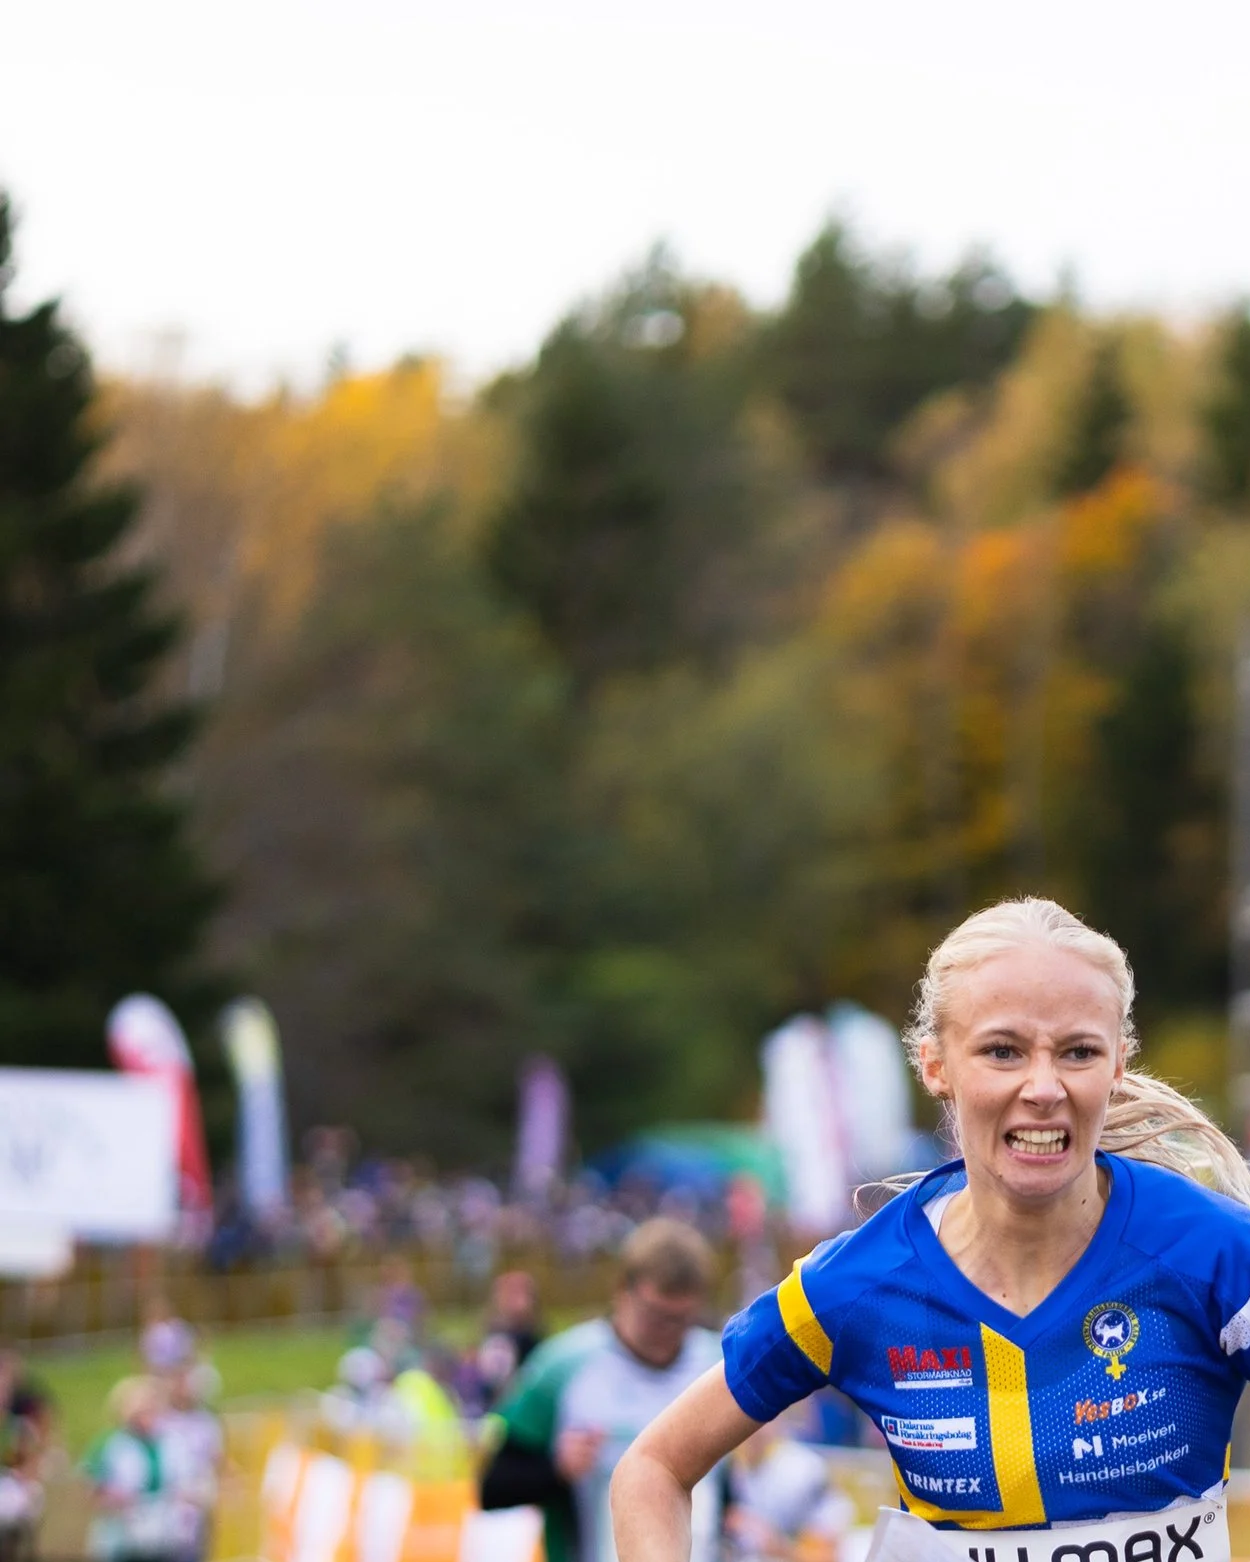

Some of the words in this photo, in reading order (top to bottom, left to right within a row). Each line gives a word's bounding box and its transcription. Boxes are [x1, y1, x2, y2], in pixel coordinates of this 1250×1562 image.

[887, 1345, 972, 1374] MAXI
[906, 1368, 972, 1380] STORMARKNAD
[1112, 1423, 1176, 1449] Moelven
[1059, 1444, 1189, 1484] Handelsbanken
[905, 1469, 981, 1494] TRIMTEX
